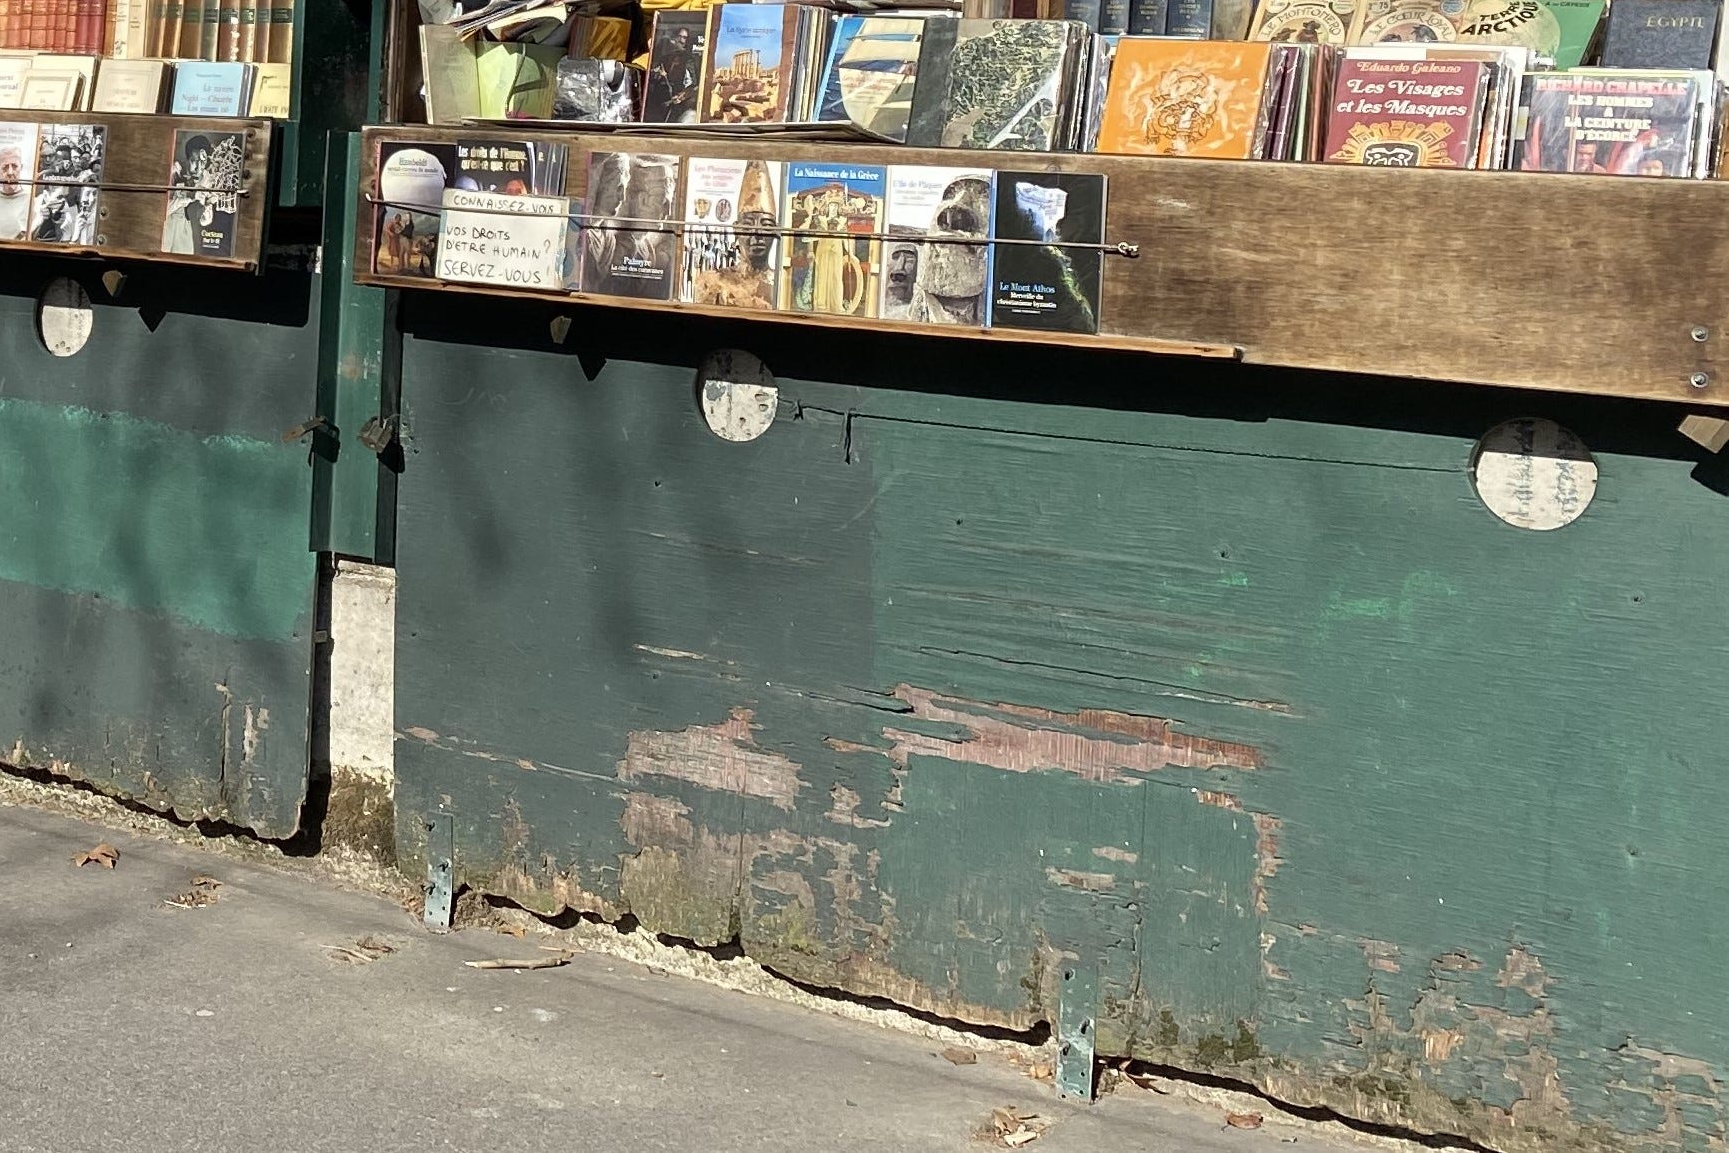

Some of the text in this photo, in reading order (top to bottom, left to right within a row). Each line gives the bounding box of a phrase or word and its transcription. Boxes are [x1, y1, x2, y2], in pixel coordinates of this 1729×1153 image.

[1461, 1, 1539, 35] ARCTIQUE
[1480, 1, 1520, 21] TERRE
[1426, 12, 1455, 40] LOYAL
[1357, 61, 1461, 74] Eduardo Galeano
[1347, 79, 1465, 97] Les Visages
[1536, 79, 1687, 95] RICHARD CHAPELLE
[1568, 94, 1594, 106] LES
[1337, 99, 1468, 117] et les Masques
[1564, 116, 1652, 130] LA CEINTURE
[458, 146, 468, 157] Les
[470, 147, 488, 158] droits
[489, 148, 498, 158] de
[460, 159, 488, 171] qu'est-ce
[490, 161, 503, 172] que
[505, 160, 519, 172] c'est
[794, 167, 879, 181] La Naissance de la Grèce
[446, 225, 511, 241] VOS DROITS
[446, 239, 551, 259] D'ETRE HUMAIN ?
[623, 256, 652, 268] Palmyre
[443, 259, 542, 284] SERVEZ-VOUS
[999, 281, 1055, 294] Le Mont Athos
[1010, 292, 1035, 300] Merveille
